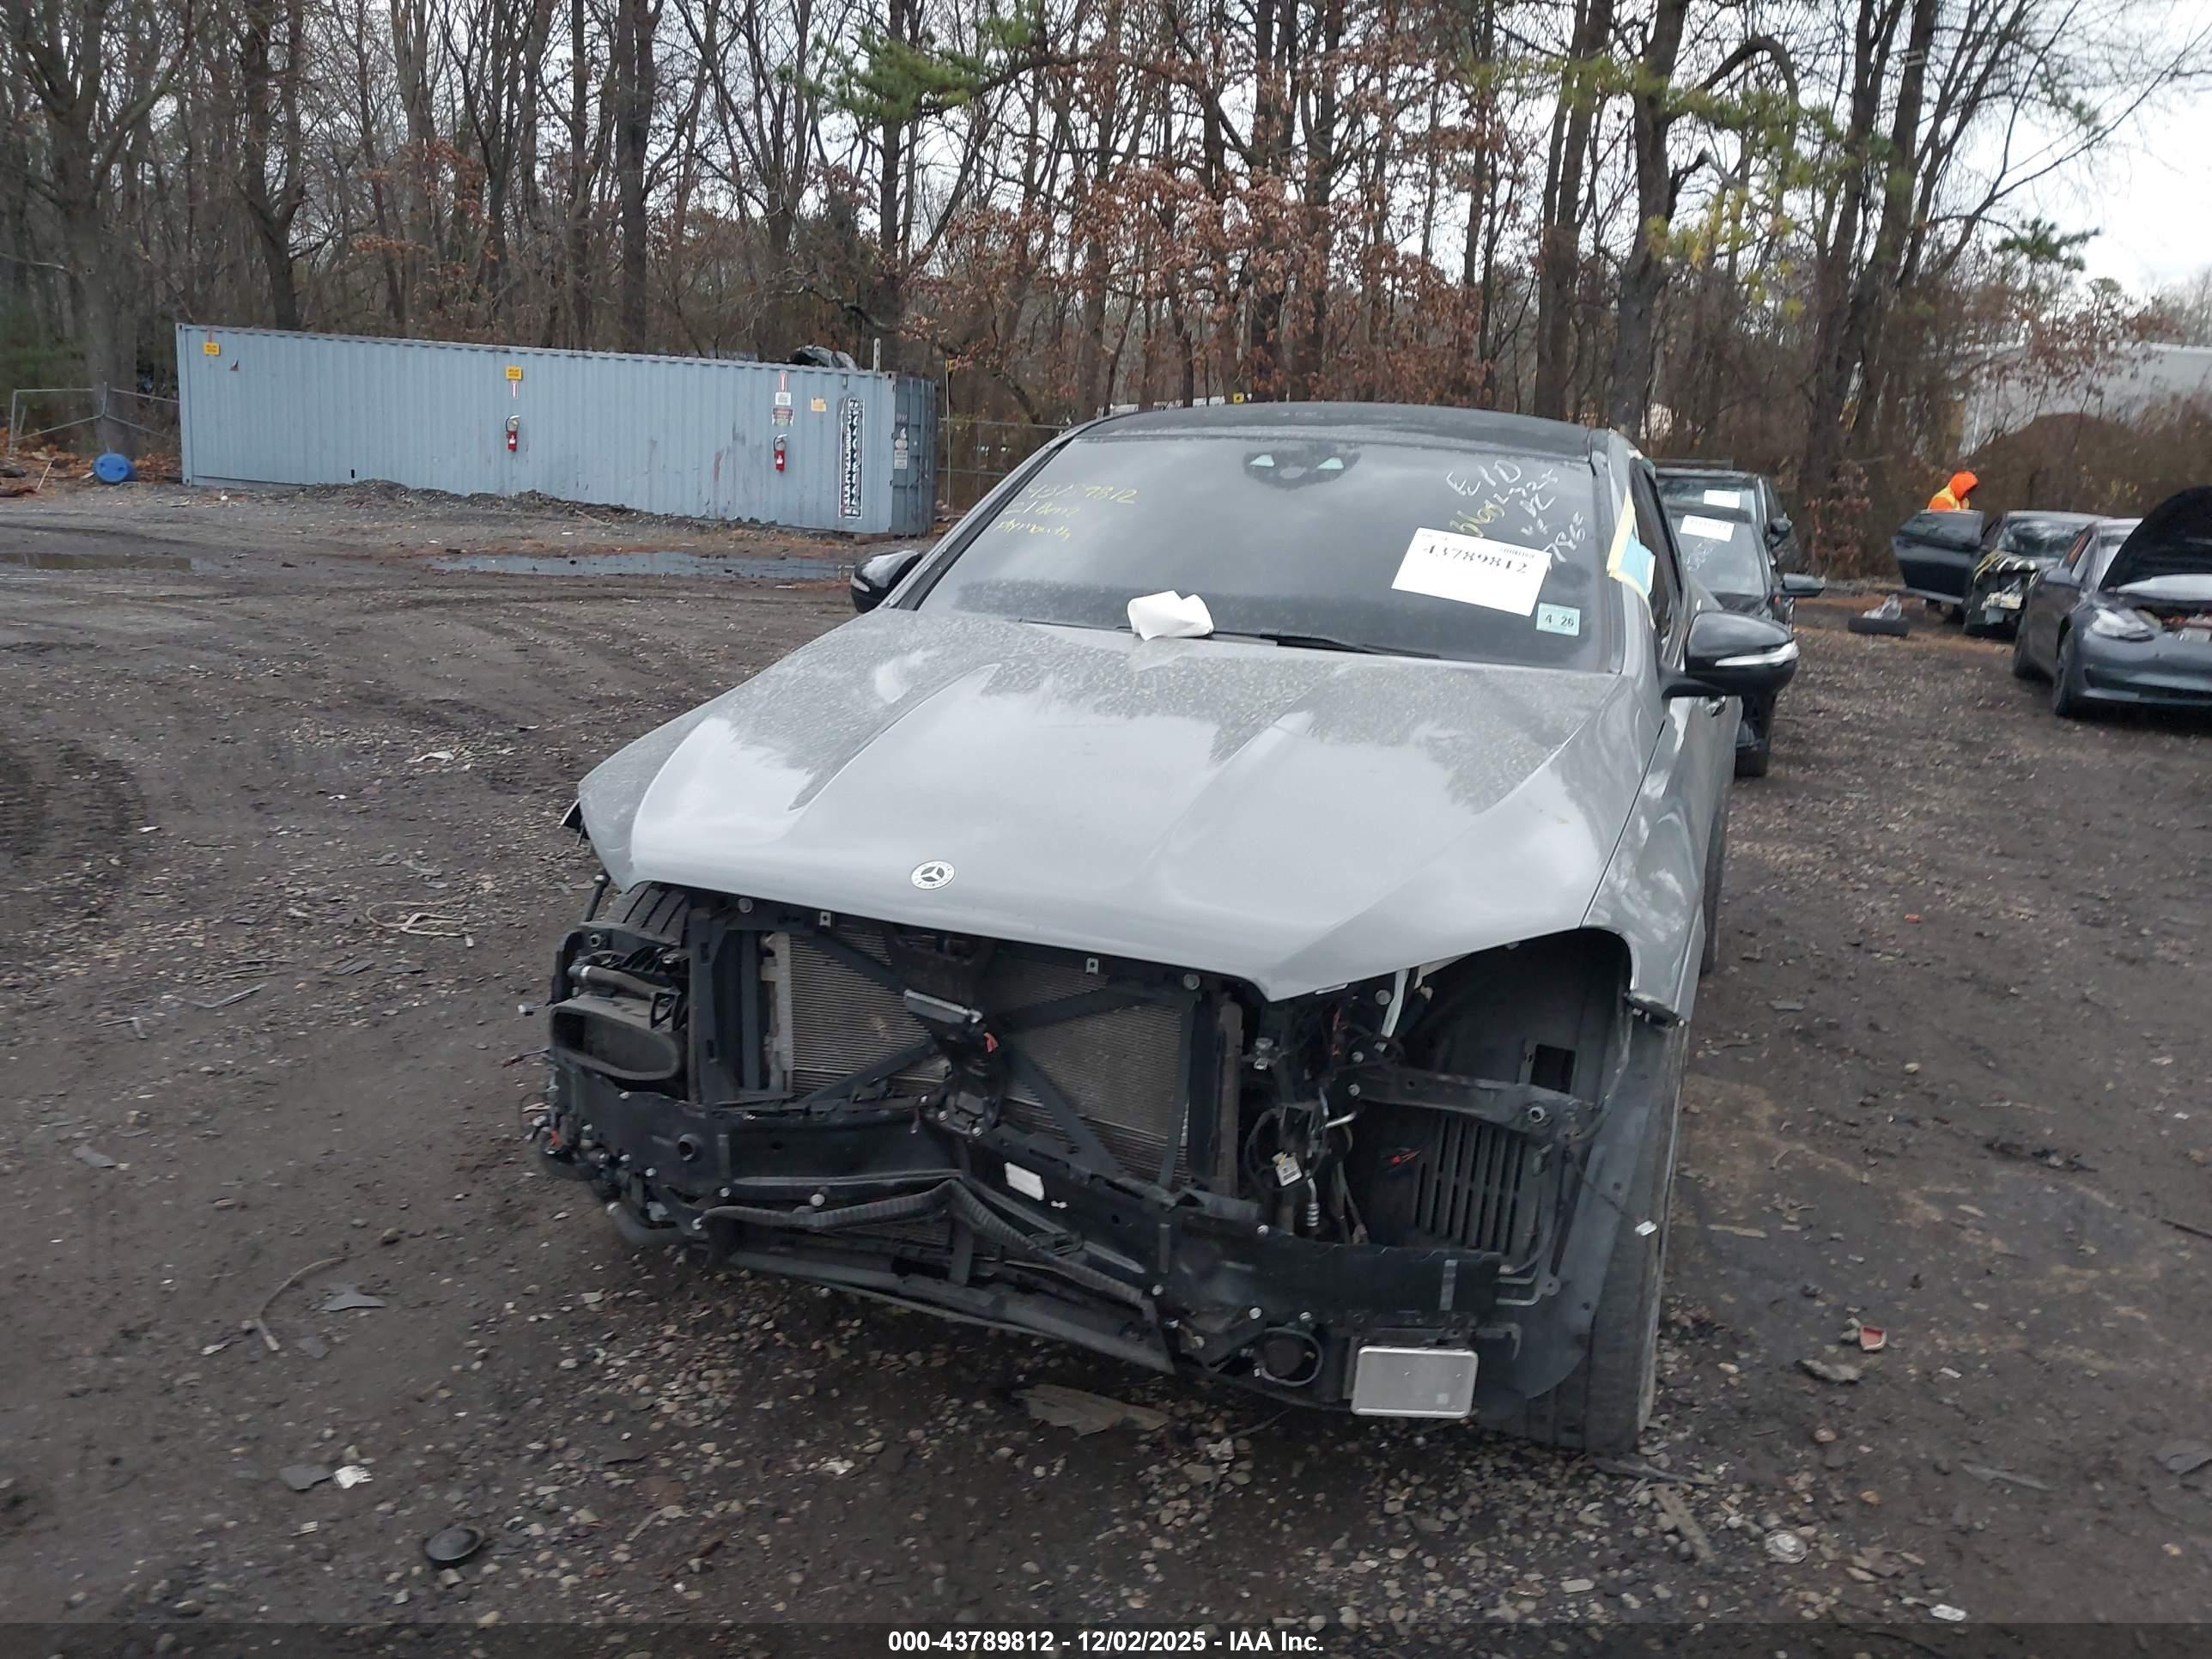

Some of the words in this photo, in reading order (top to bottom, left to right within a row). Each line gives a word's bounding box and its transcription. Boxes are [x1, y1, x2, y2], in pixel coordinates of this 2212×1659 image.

[1422, 544, 1528, 574] 43789812
[1544, 613, 1553, 624] 4
[1560, 615, 1575, 628] 26
